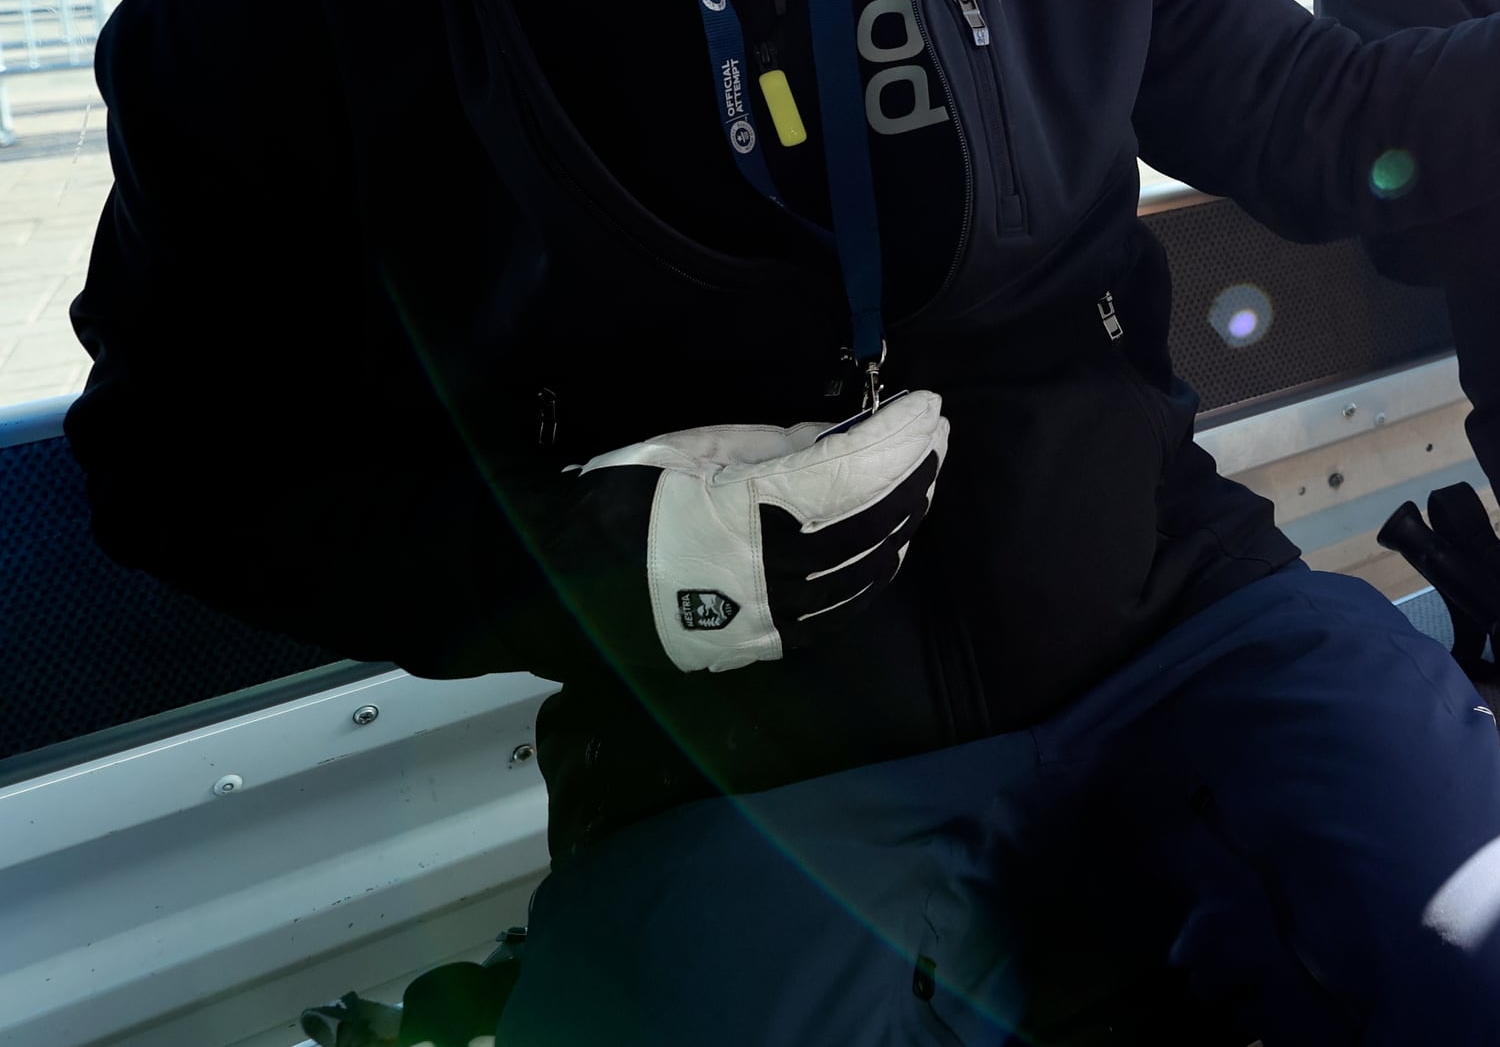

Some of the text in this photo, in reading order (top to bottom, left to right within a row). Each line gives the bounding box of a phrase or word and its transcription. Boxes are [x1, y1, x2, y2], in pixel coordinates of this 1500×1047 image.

[721, 59, 735, 117] OFFICIAL
[730, 58, 744, 113] ATTEMPT
[680, 593, 695, 627] HESTRA
